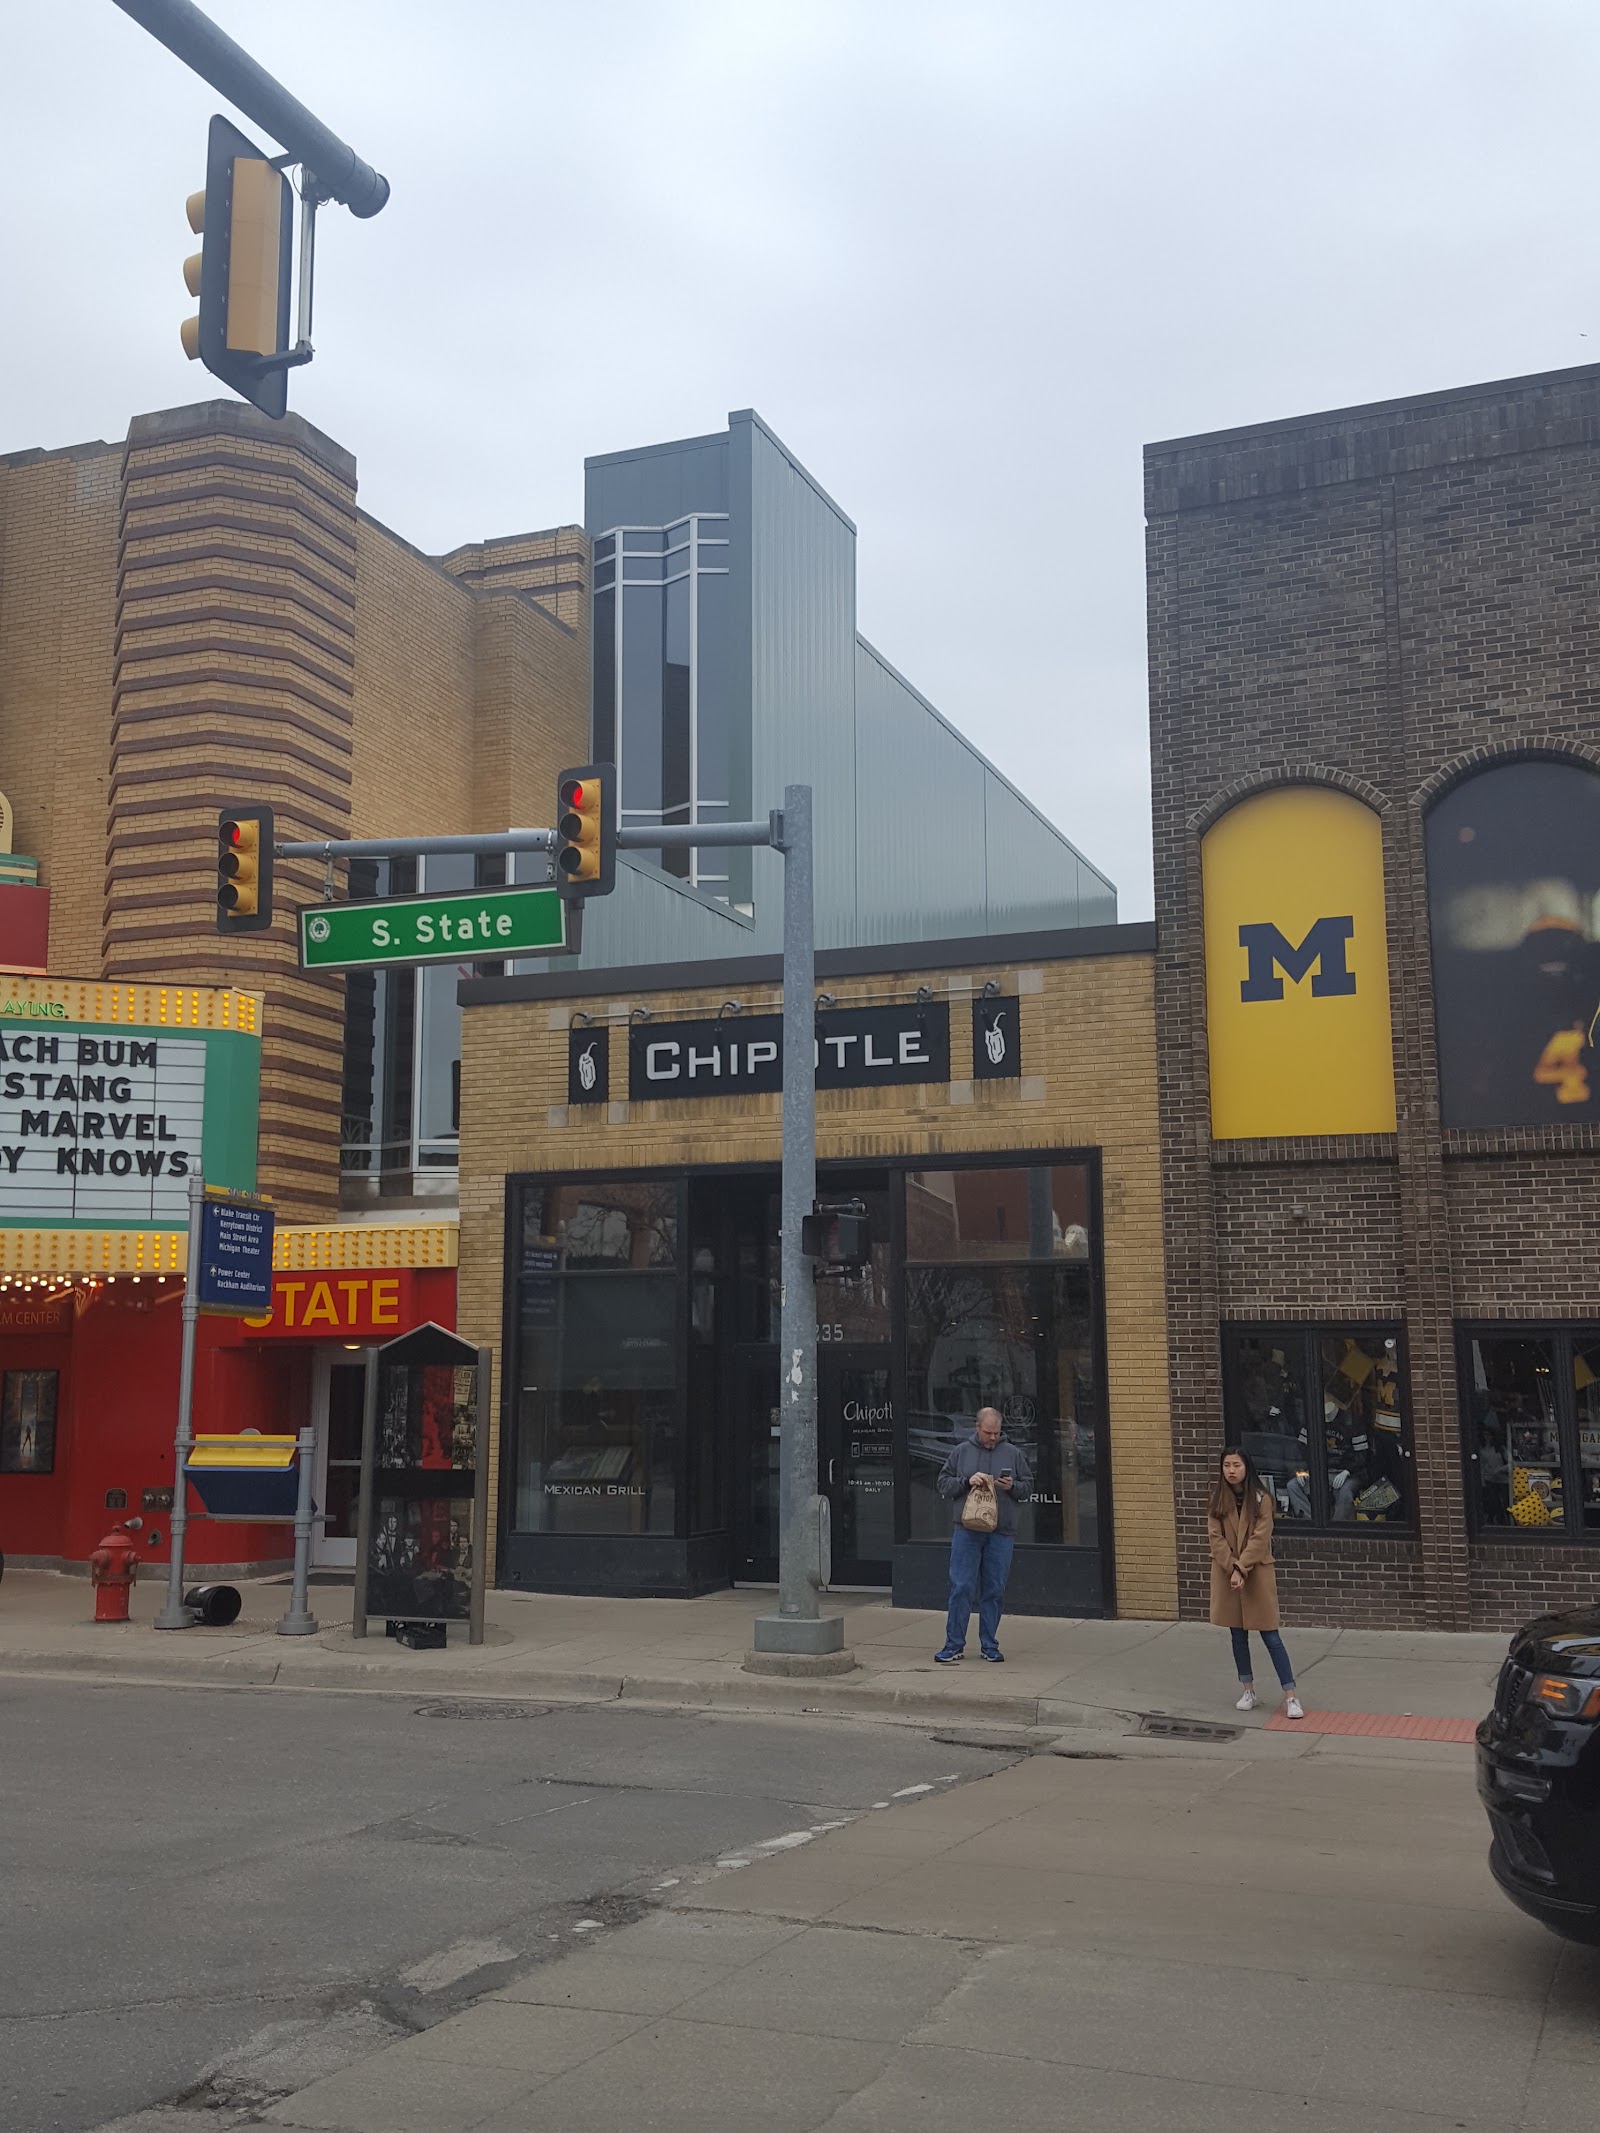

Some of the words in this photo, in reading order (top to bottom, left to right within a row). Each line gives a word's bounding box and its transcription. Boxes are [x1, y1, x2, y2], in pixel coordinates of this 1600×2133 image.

[371, 919, 400, 947] S.
[416, 910, 513, 943] State
[1238, 915, 1357, 1003] M
[0, 1001, 65, 1017] AYING
[79, 1039, 157, 1068] BUM
[645, 1030, 930, 1081] CHIPTLE
[1533, 1029, 1590, 1105] 4
[3, 1072, 132, 1103] STANG
[20, 1109, 177, 1141] MARVEL
[0, 1146, 26, 1174] Y
[56, 1147, 190, 1177] KNOWS
[221, 1208, 234, 1218] Blake
[236, 1210, 252, 1220] Transit
[220, 1220, 245, 1231] Kerrytown
[246, 1223, 263, 1233] District
[219, 1231, 231, 1240] Main
[233, 1233, 247, 1242] Street
[248, 1235, 259, 1244] Area
[219, 1243, 240, 1254] Michigan
[242, 1246, 260, 1255] Theater
[217, 1268, 233, 1277] Power
[235, 1270, 251, 1279] Center
[217, 1279, 239, 1289] Rackham
[240, 1282, 266, 1292] Auditorium
[0, 1311, 13, 1325] M
[15, 1311, 60, 1325] CENTER
[544, 1485, 601, 1495] MEXICAN
[607, 1485, 646, 1495] GRILL
